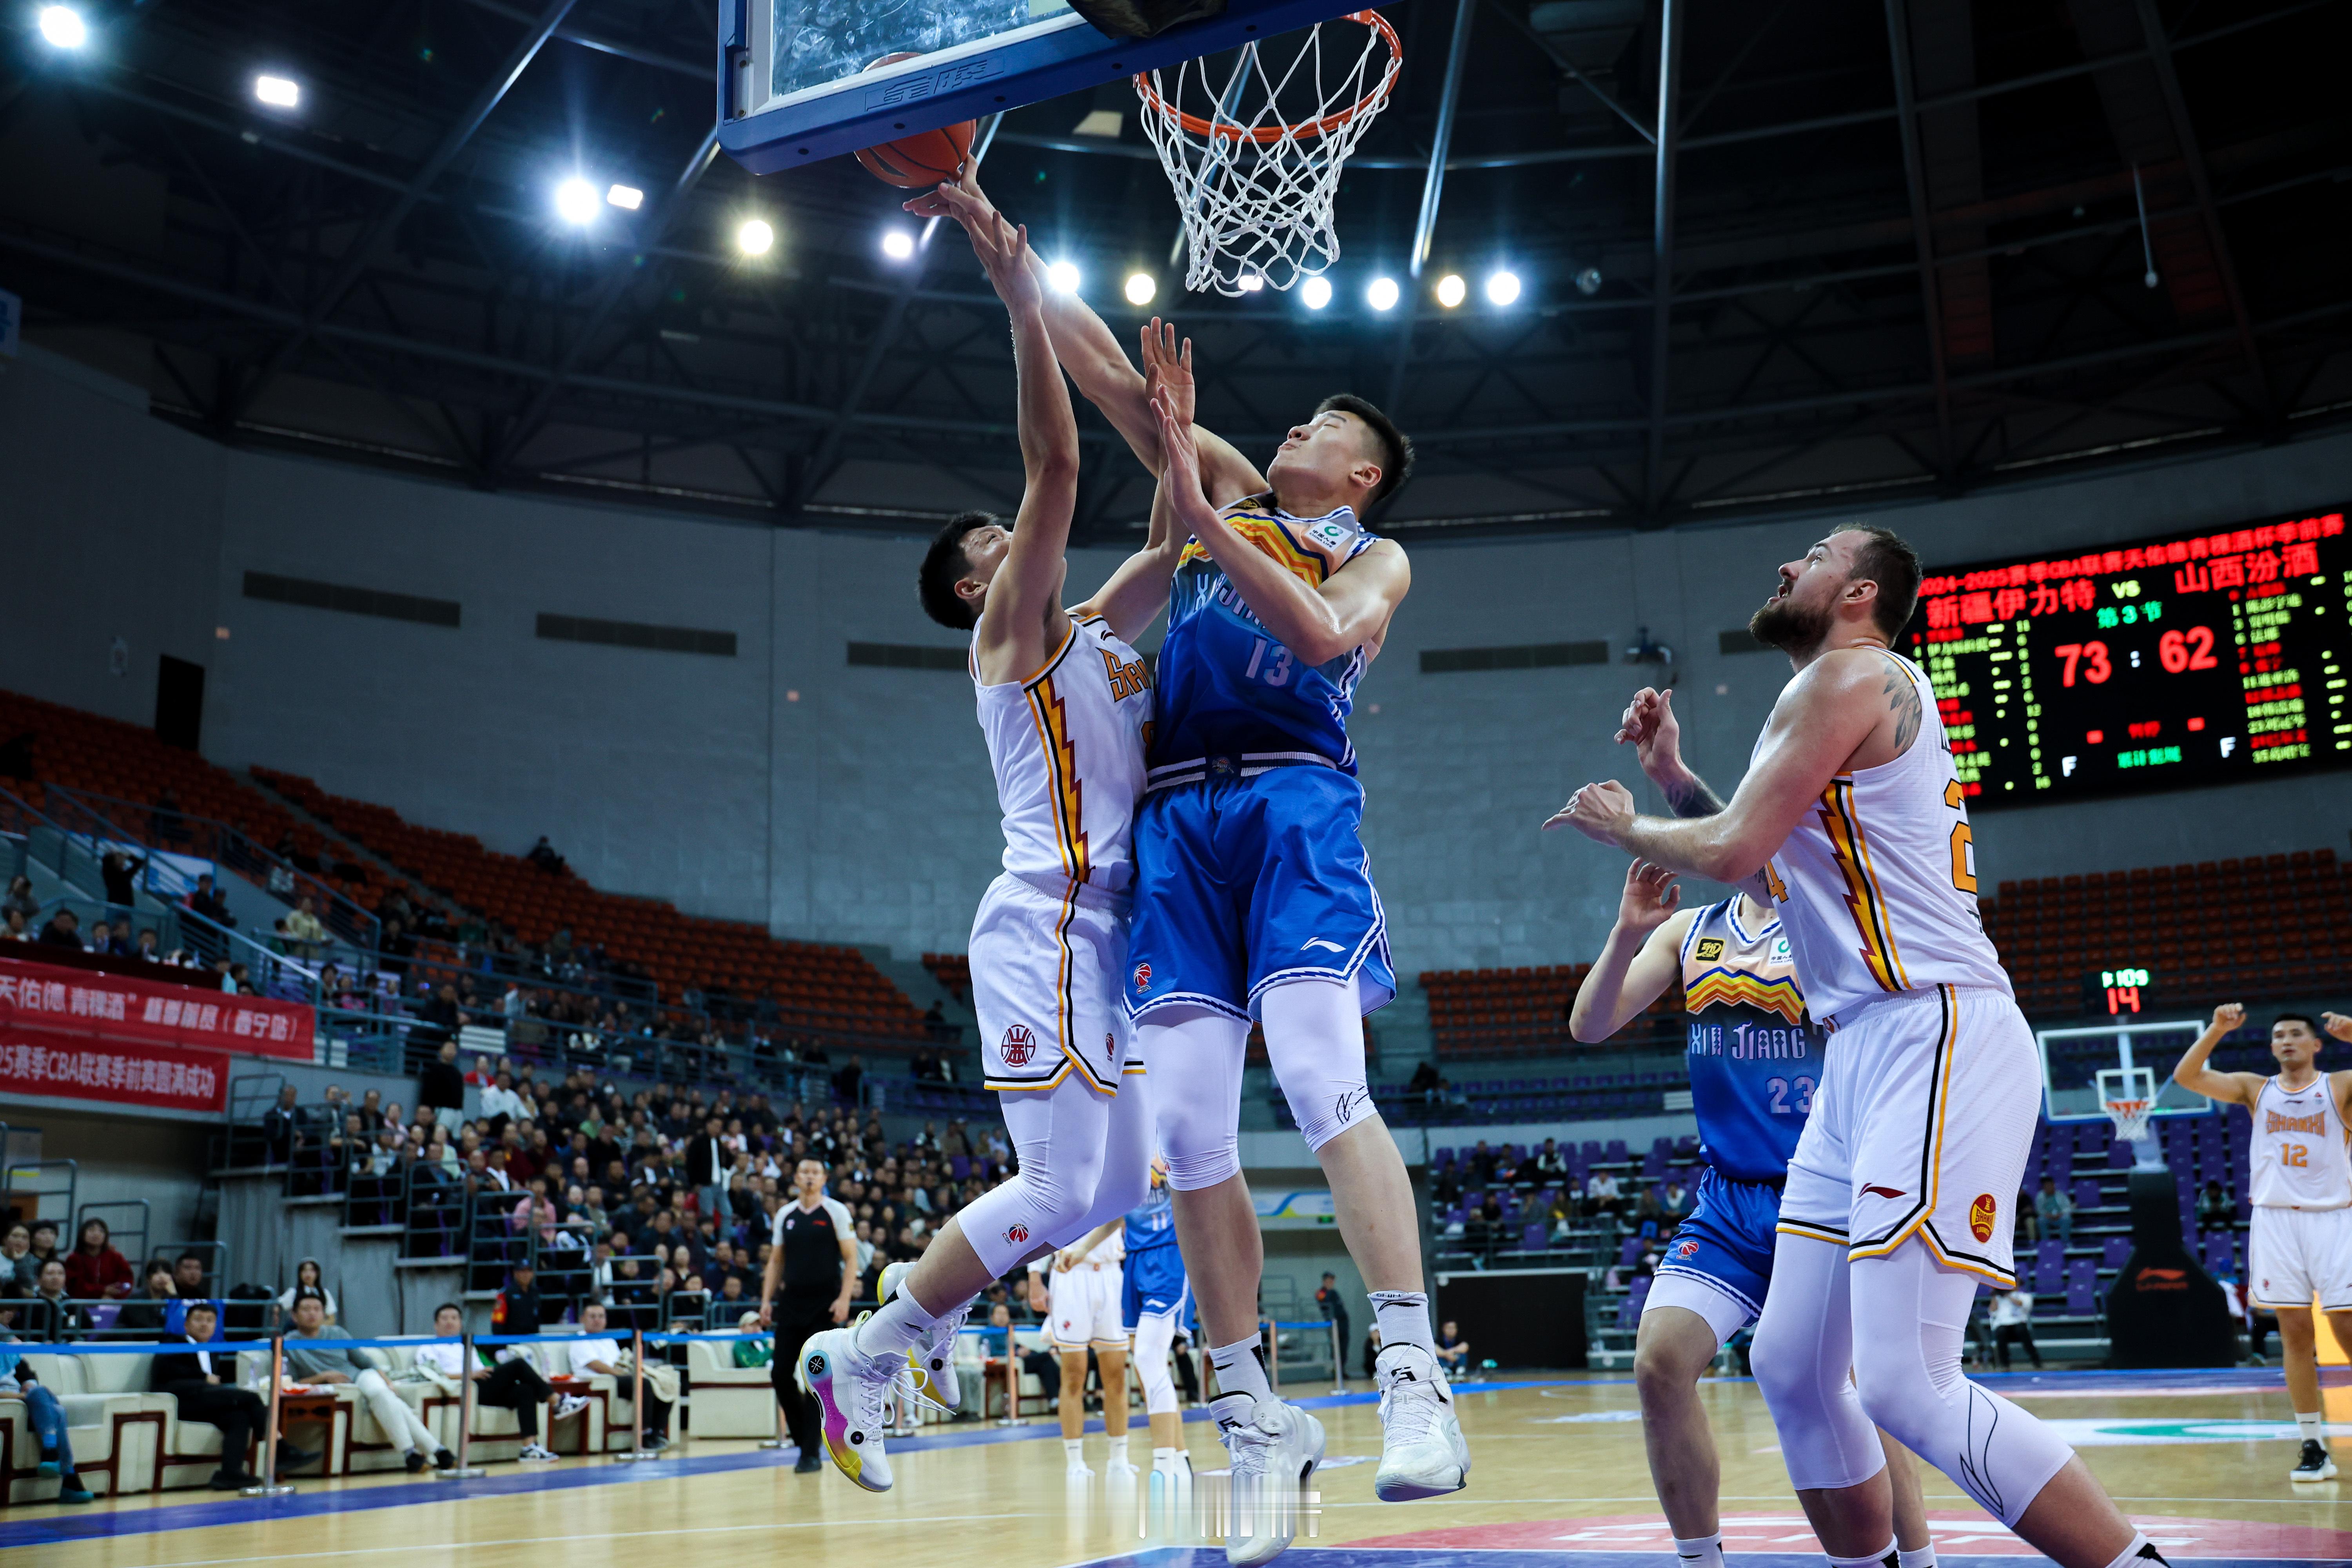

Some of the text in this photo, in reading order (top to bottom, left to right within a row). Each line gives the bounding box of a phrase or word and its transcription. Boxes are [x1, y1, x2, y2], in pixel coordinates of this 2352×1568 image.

[1309, 532, 1322, 542] CHINA
[2174, 541, 2319, 593] 山西汾酒
[1245, 635, 1294, 686] 13
[2055, 641, 2112, 687] 73
[2160, 626, 2218, 673] 62
[2220, 737, 2236, 758] F
[2062, 756, 2077, 777] F
[2107, 986, 2140, 1014] 14
[1731, 1019, 1806, 1060] JIANG
[1766, 1076, 1815, 1114] 23
[2265, 1109, 2326, 1138] SHANXI
[2280, 1142, 2308, 1167] 12
[1002, 1232, 1012, 1247] CBA
